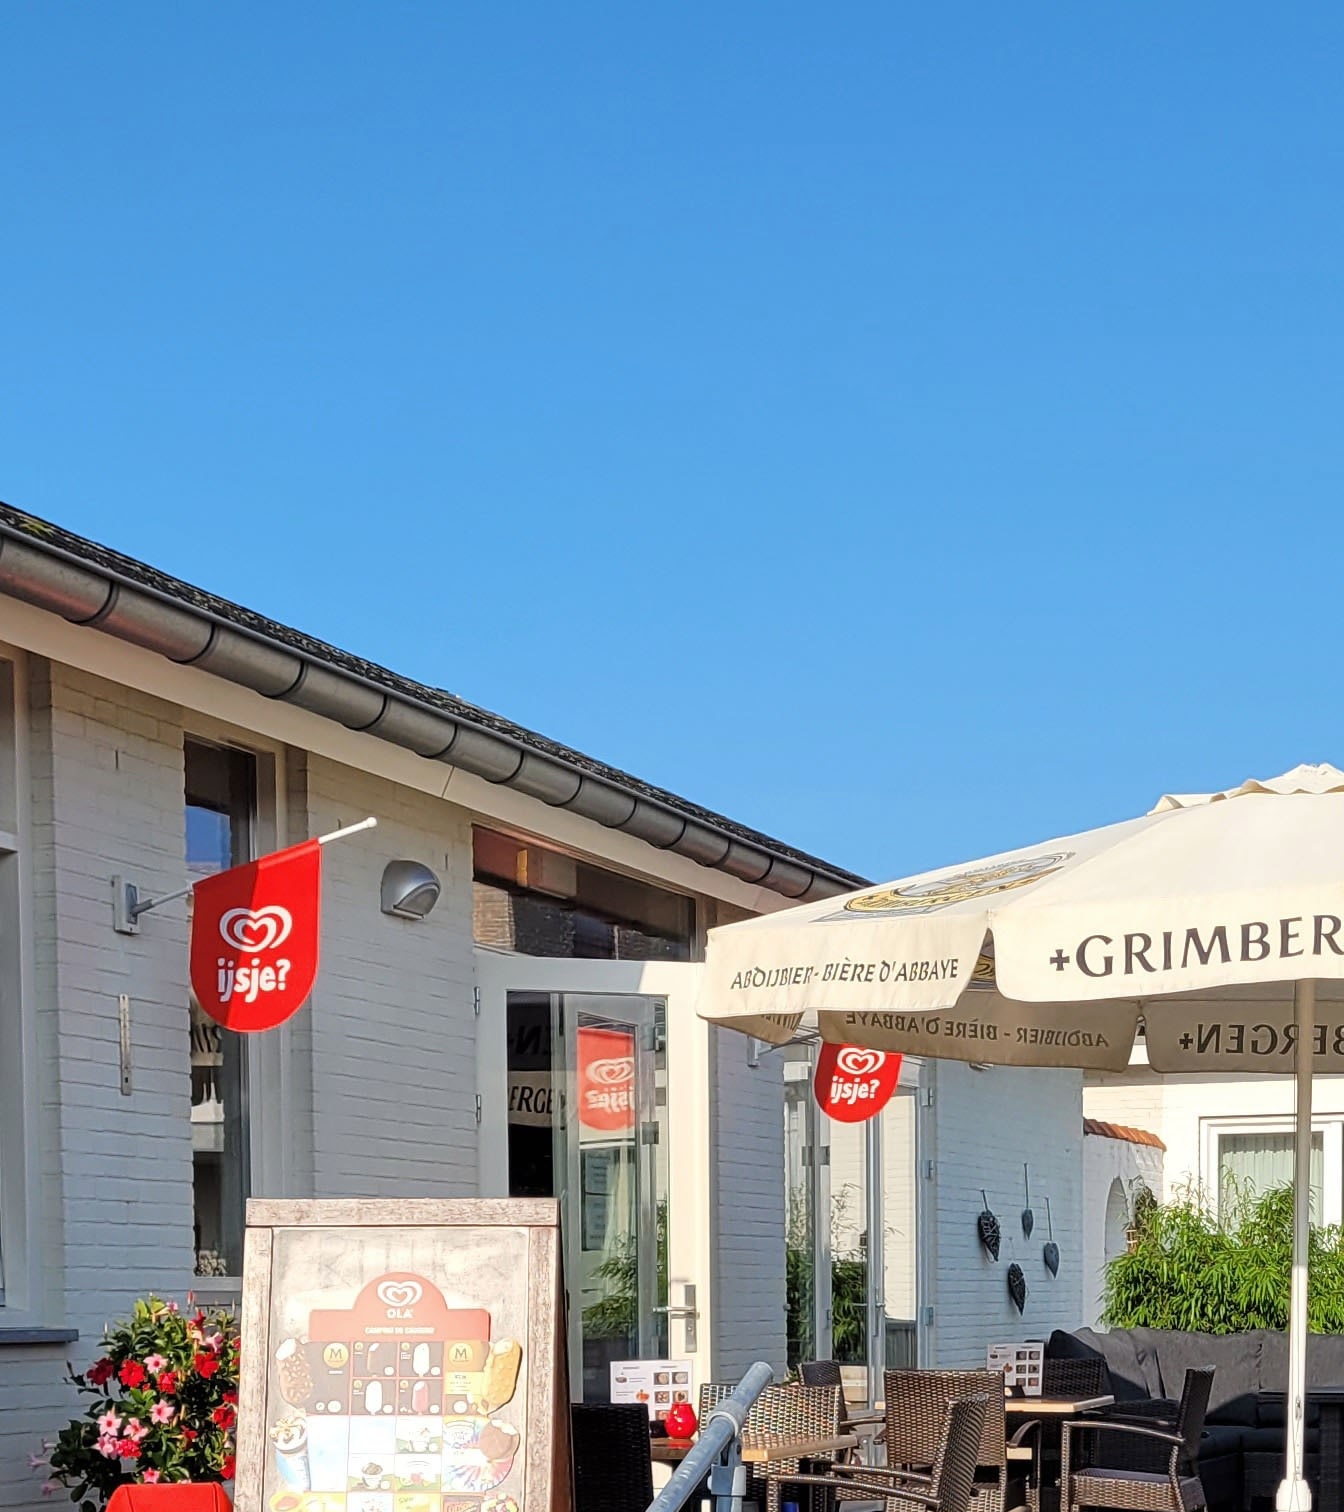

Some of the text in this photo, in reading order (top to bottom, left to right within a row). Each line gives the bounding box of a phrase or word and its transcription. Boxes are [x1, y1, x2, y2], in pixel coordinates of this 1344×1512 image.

[217, 957, 291, 1003] ijsje?
[730, 957, 959, 990] ABDIJBIER BIÈRE D'ABBAYE
[830, 1075, 880, 1105] ijsje?
[386, 1308, 413, 1319] OLA
